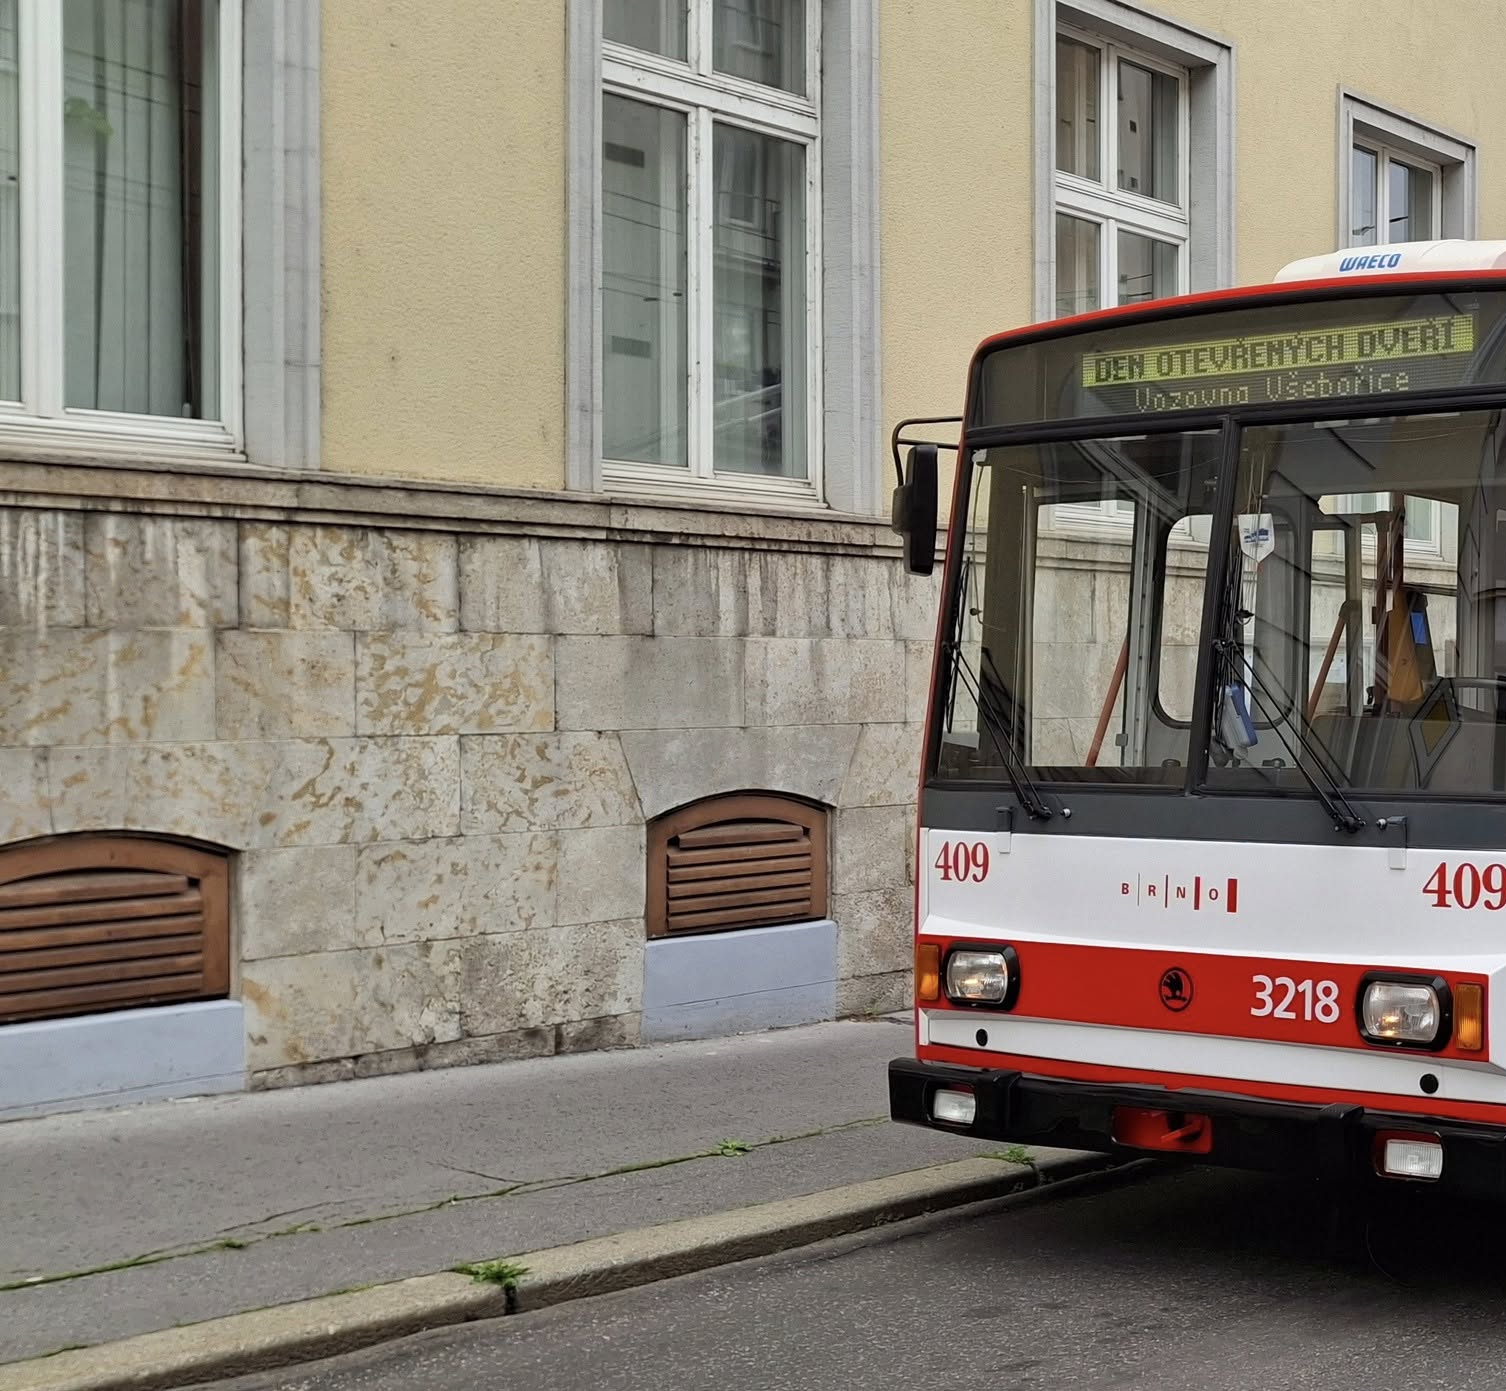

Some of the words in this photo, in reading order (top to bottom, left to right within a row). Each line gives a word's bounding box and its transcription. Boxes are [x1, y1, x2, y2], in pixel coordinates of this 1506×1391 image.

[1339, 253, 1402, 272] WAECO
[1095, 355, 1141, 384] DEN
[1157, 332, 1344, 377] OTEVŘENÝCH
[1358, 316, 1454, 359] DVEŘÍ
[1136, 386, 1248, 412] Vozovna
[1266, 365, 1409, 401] Všebořice
[934, 841, 990, 883] 409
[1250, 975, 1340, 1023] 3218
